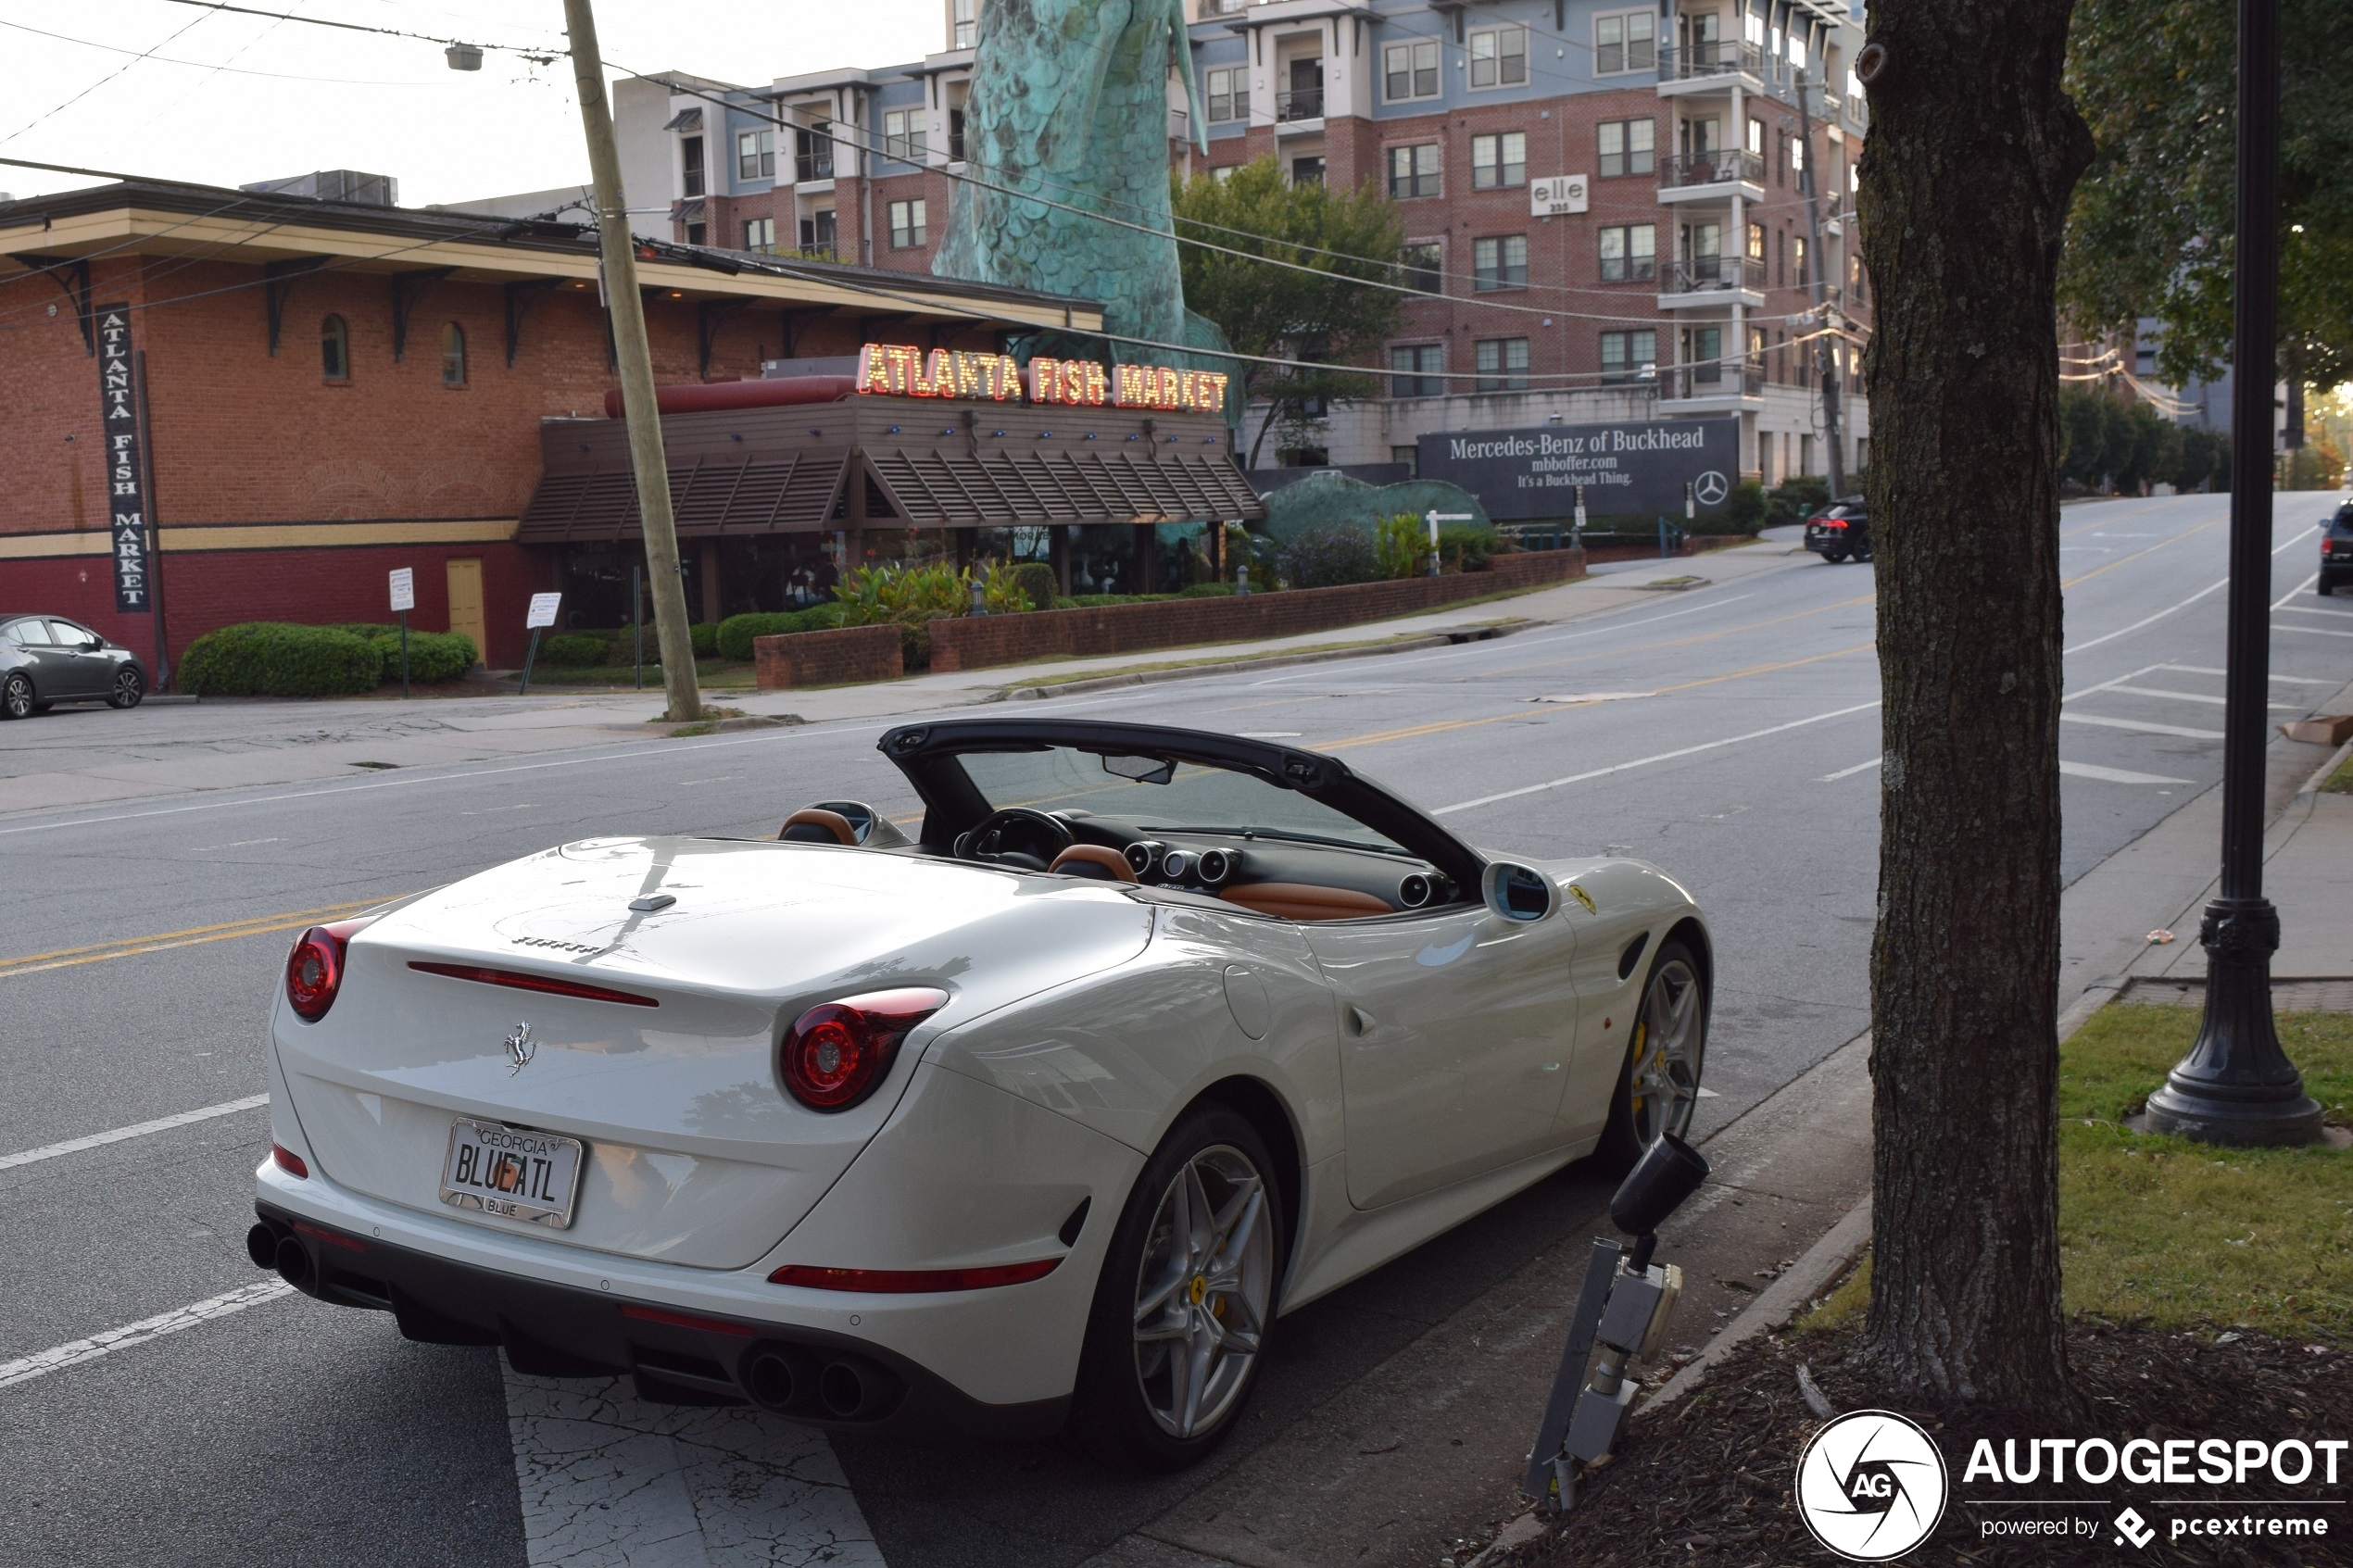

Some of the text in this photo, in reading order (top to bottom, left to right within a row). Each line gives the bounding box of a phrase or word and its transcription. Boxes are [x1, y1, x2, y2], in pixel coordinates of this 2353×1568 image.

[1534, 179, 1582, 201] elle
[1550, 203, 1568, 213] 235
[859, 344, 1228, 412] ATLANTA FISH MARKET
[1451, 426, 1705, 459] Mercedes-Benz of Buckhead
[103, 313, 143, 604] ATLANTA FISH MARKET
[1531, 455, 1617, 472] mbboffer.com
[1517, 472, 1633, 488] It's a Buckhead Thing.
[480, 1130, 547, 1156] GEORGIA
[455, 1143, 555, 1202] BLUEATL
[487, 1200, 517, 1217] BLUE
